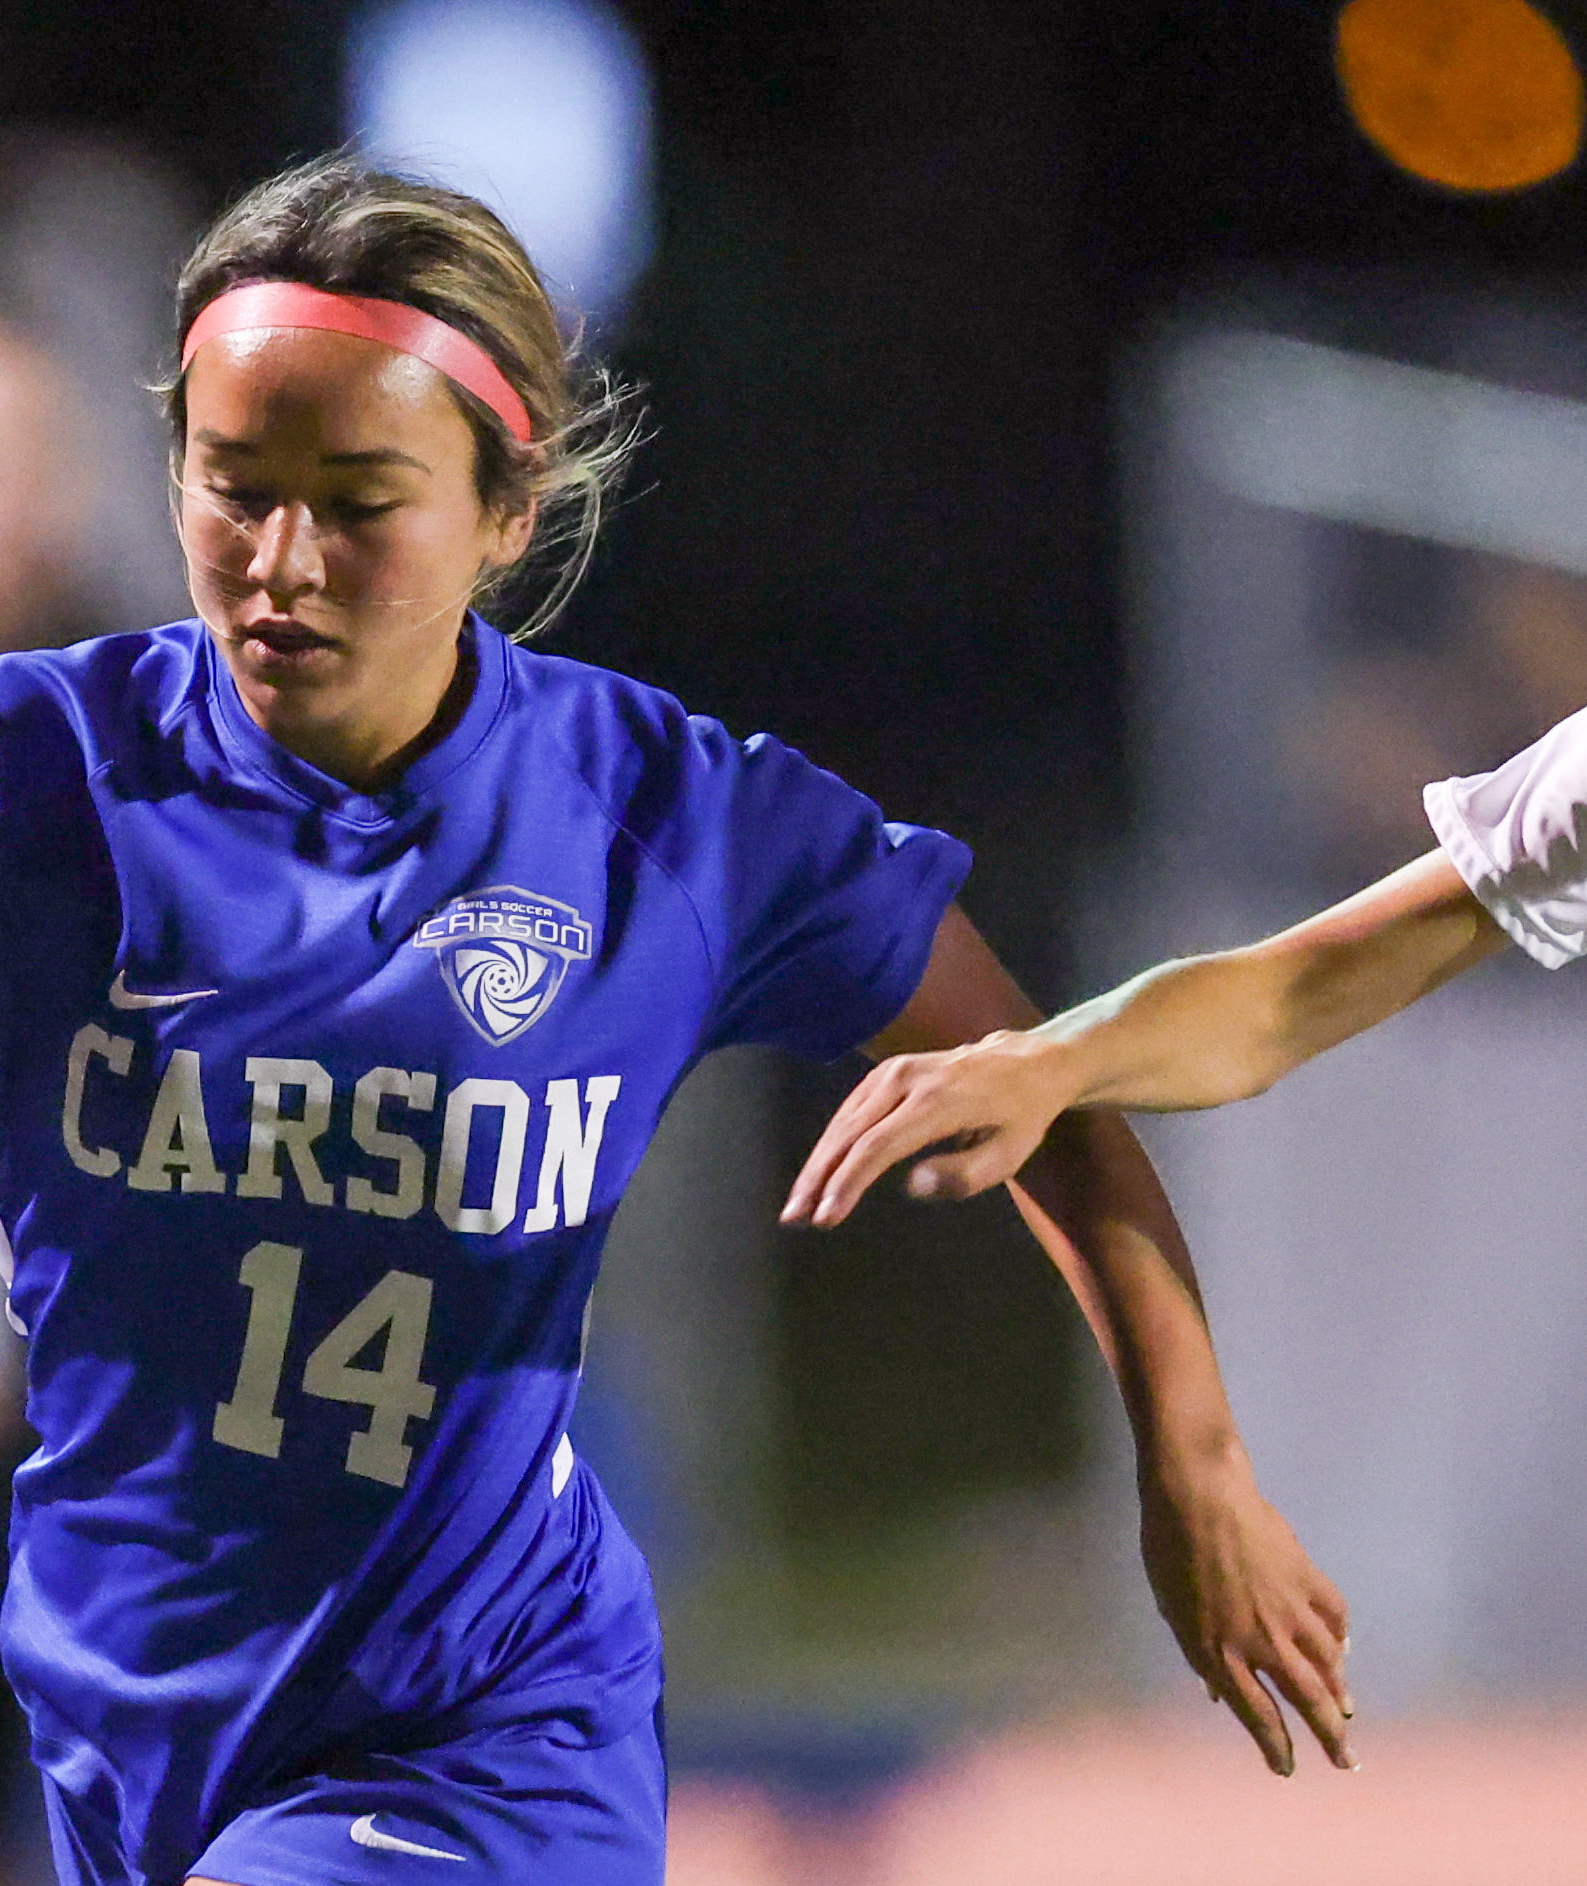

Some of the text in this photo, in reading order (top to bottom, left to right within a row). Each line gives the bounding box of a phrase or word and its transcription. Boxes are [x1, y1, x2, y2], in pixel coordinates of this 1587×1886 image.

[420, 912, 585, 951] CARSON
[457, 901, 553, 918] GIRLS SOCCER
[62, 1023, 621, 1236] CARSON
[213, 1240, 437, 1489] 14
